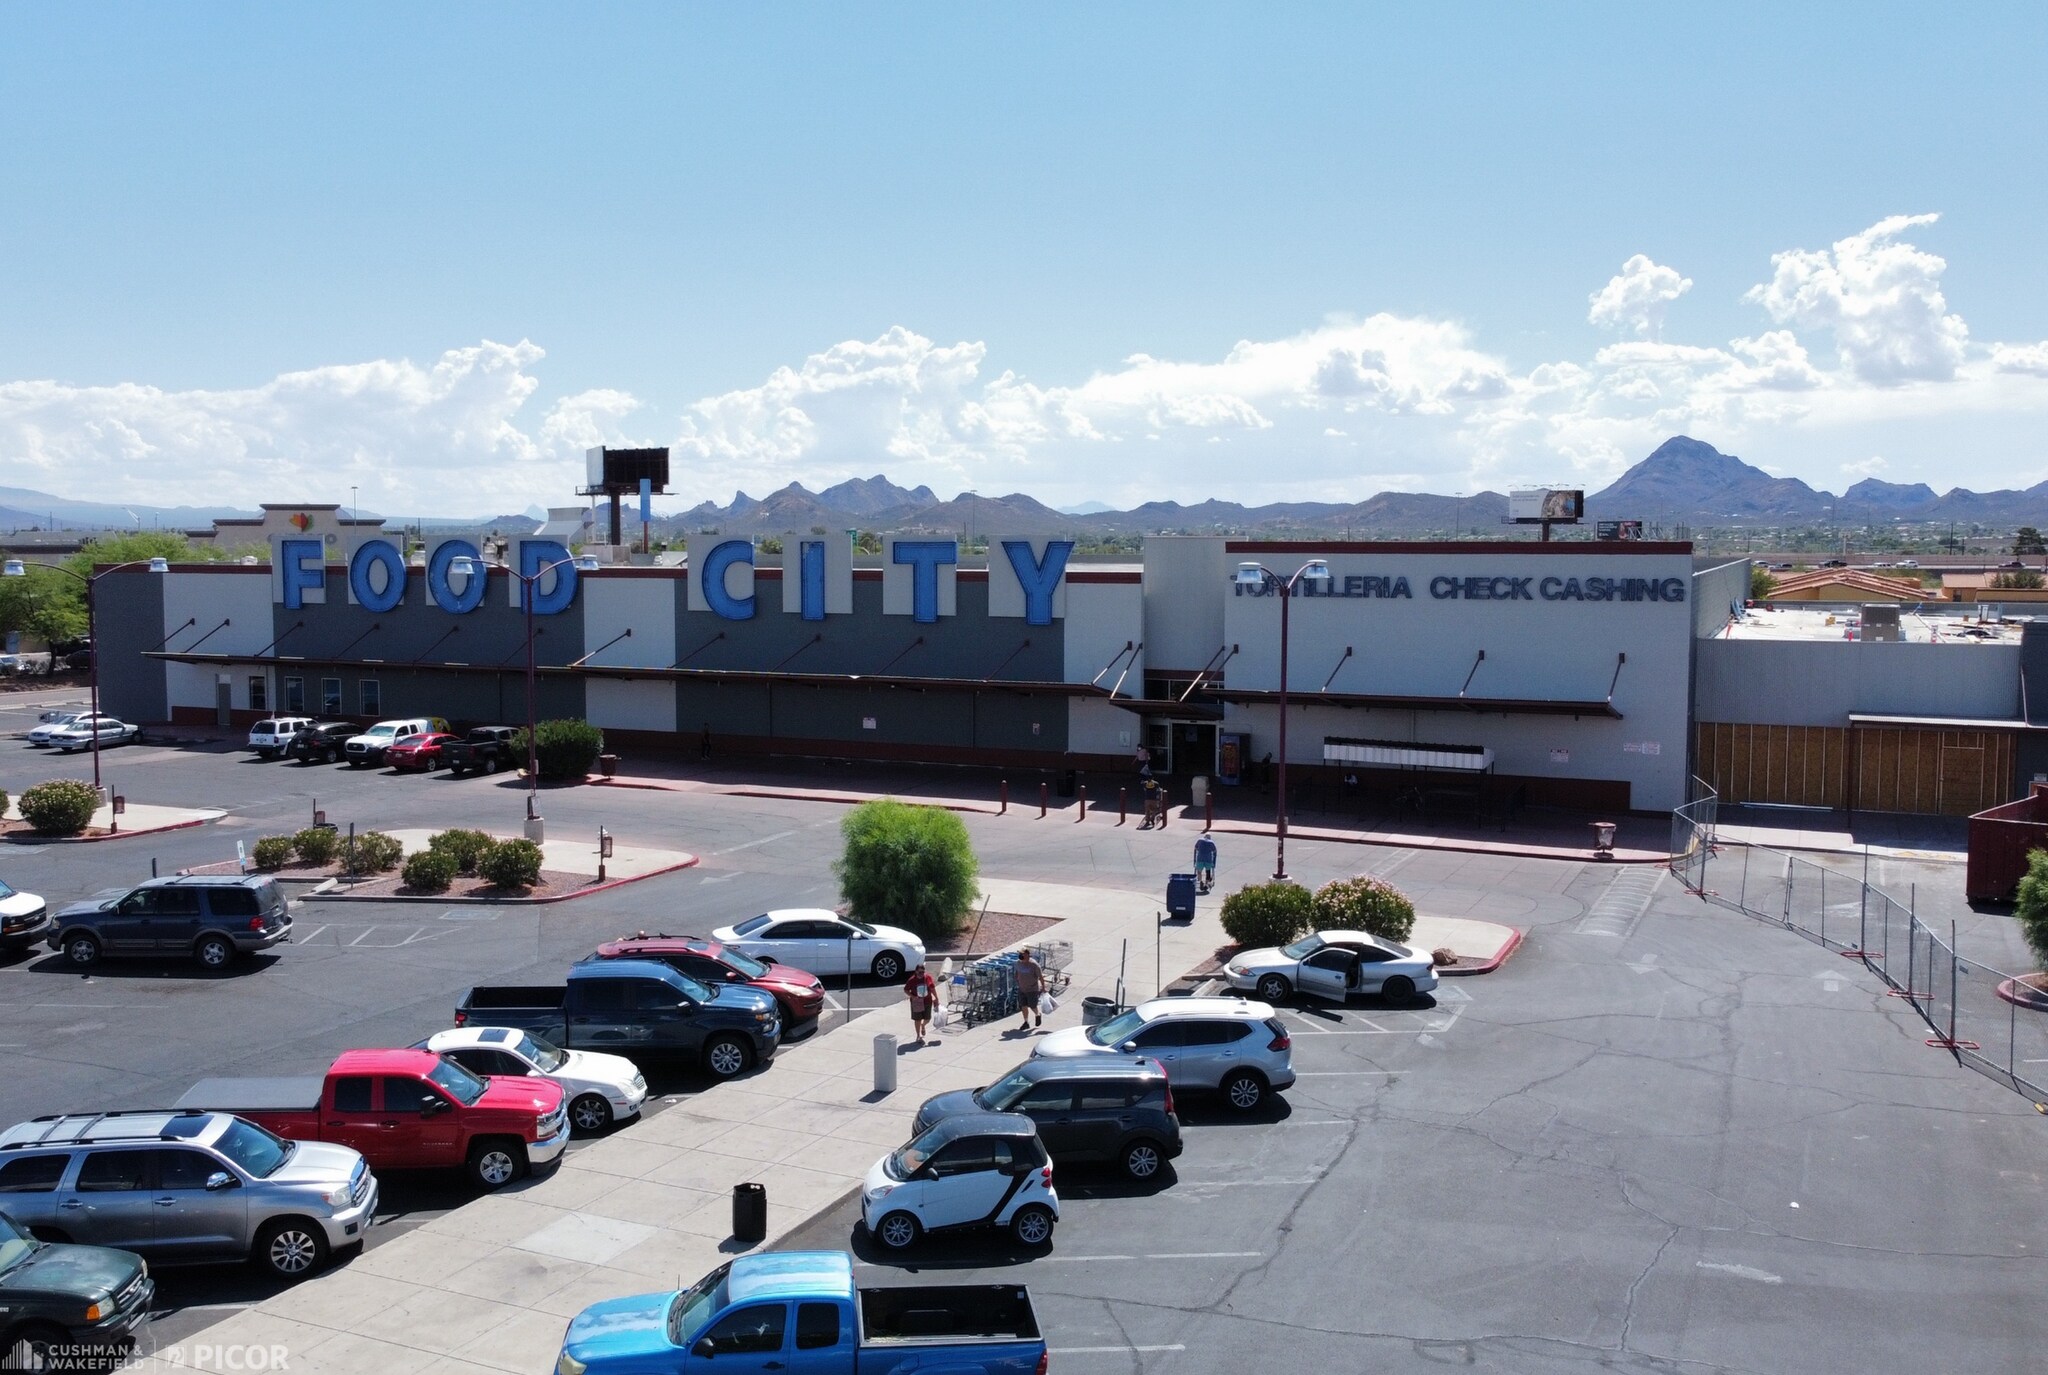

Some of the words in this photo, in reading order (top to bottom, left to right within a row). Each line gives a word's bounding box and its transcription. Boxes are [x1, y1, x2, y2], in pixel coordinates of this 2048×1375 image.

[281, 539, 579, 616] FOOD
[702, 540, 1075, 626] CITY
[1429, 576, 1533, 600] CHECK
[1539, 577, 1686, 602] CASHING
